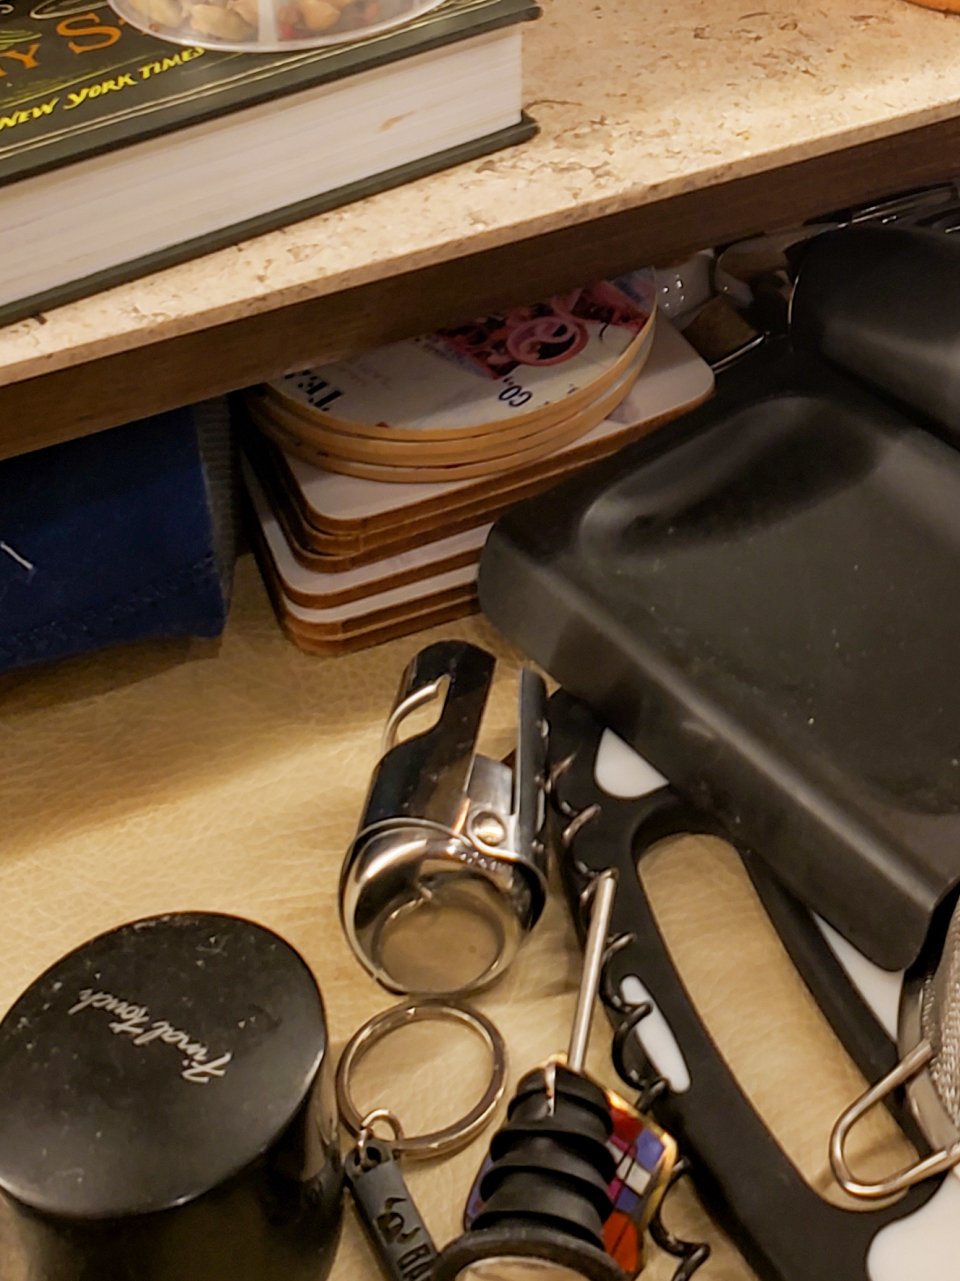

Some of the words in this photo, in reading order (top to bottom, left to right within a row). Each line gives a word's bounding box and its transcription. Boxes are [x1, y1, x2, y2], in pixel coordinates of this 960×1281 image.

[0, 98, 59, 131] NEW
[63, 73, 138, 110] YORK
[138, 46, 206, 80] TIMES
